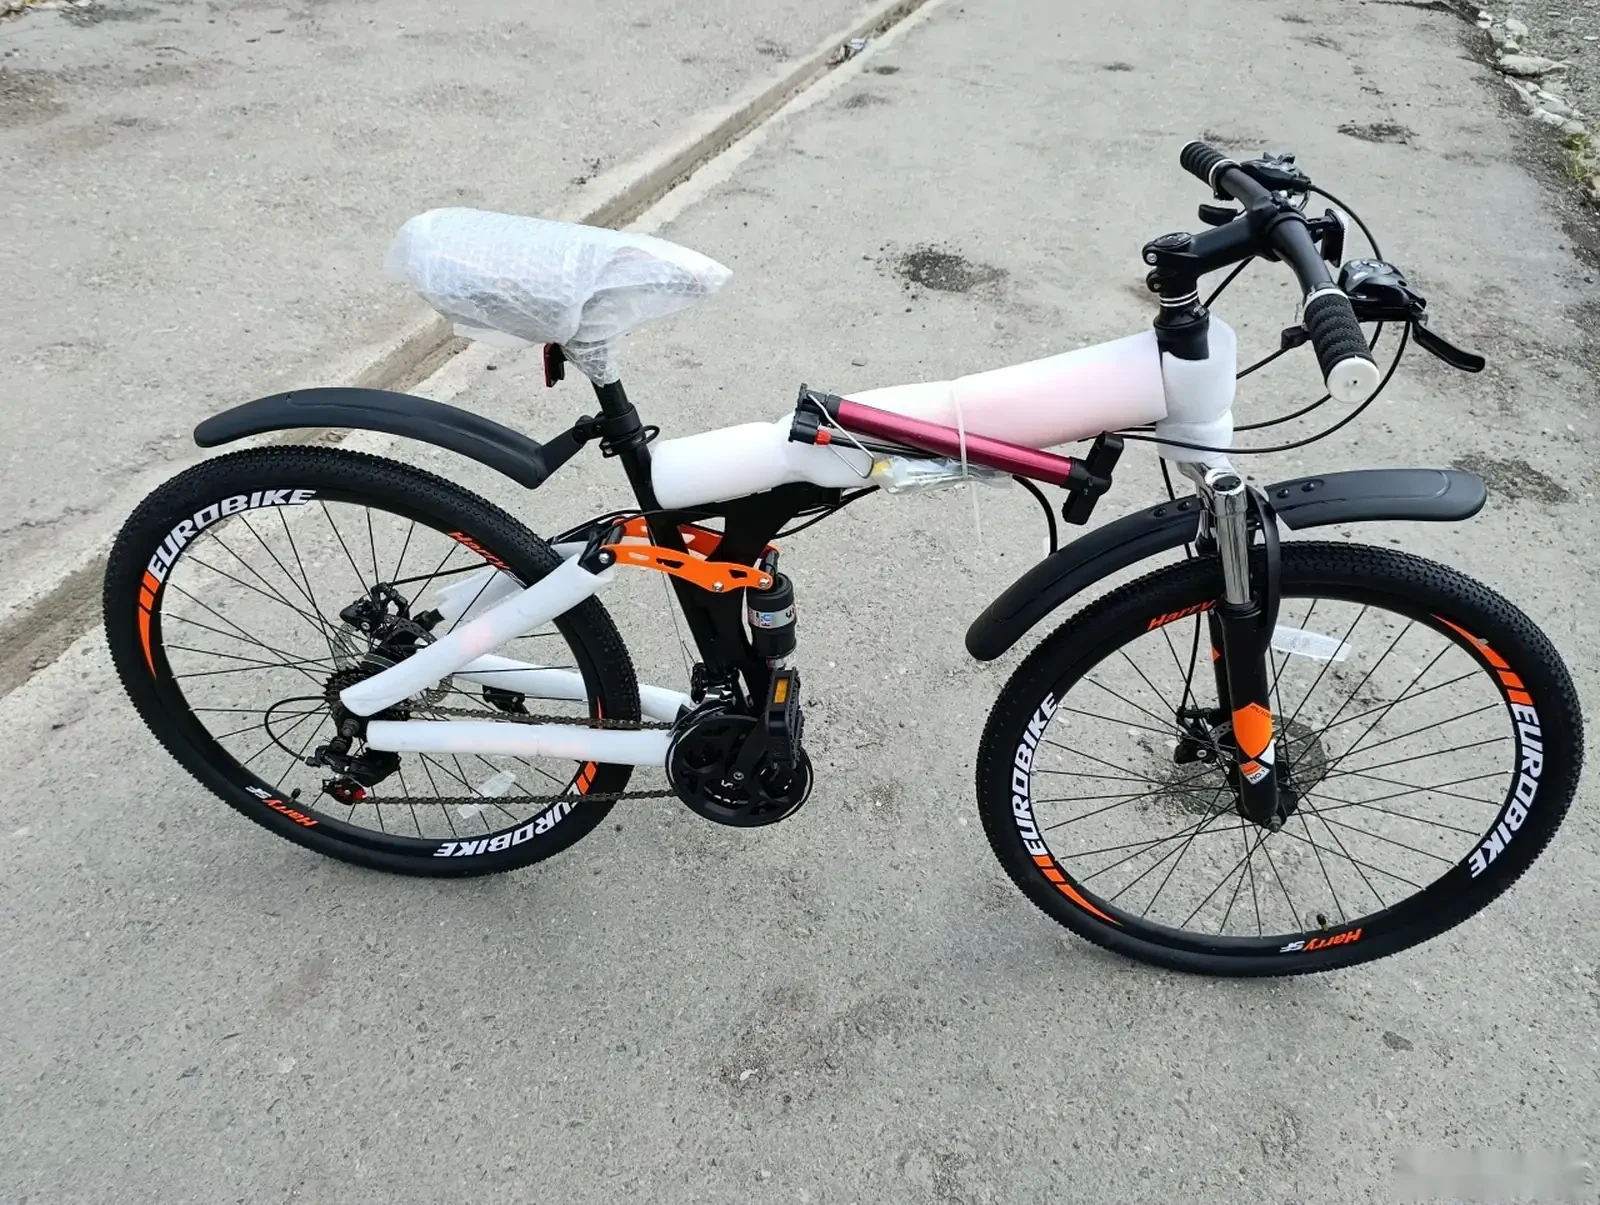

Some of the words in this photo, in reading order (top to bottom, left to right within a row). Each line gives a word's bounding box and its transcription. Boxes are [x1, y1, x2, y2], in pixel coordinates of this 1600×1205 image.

[147, 489, 316, 583] EUROBIKE
[262, 799, 319, 827] Harry
[1012, 692, 1057, 855] EUROBIKE
[1468, 703, 1543, 878] EUROBIKE
[1302, 927, 1362, 952] Harry
